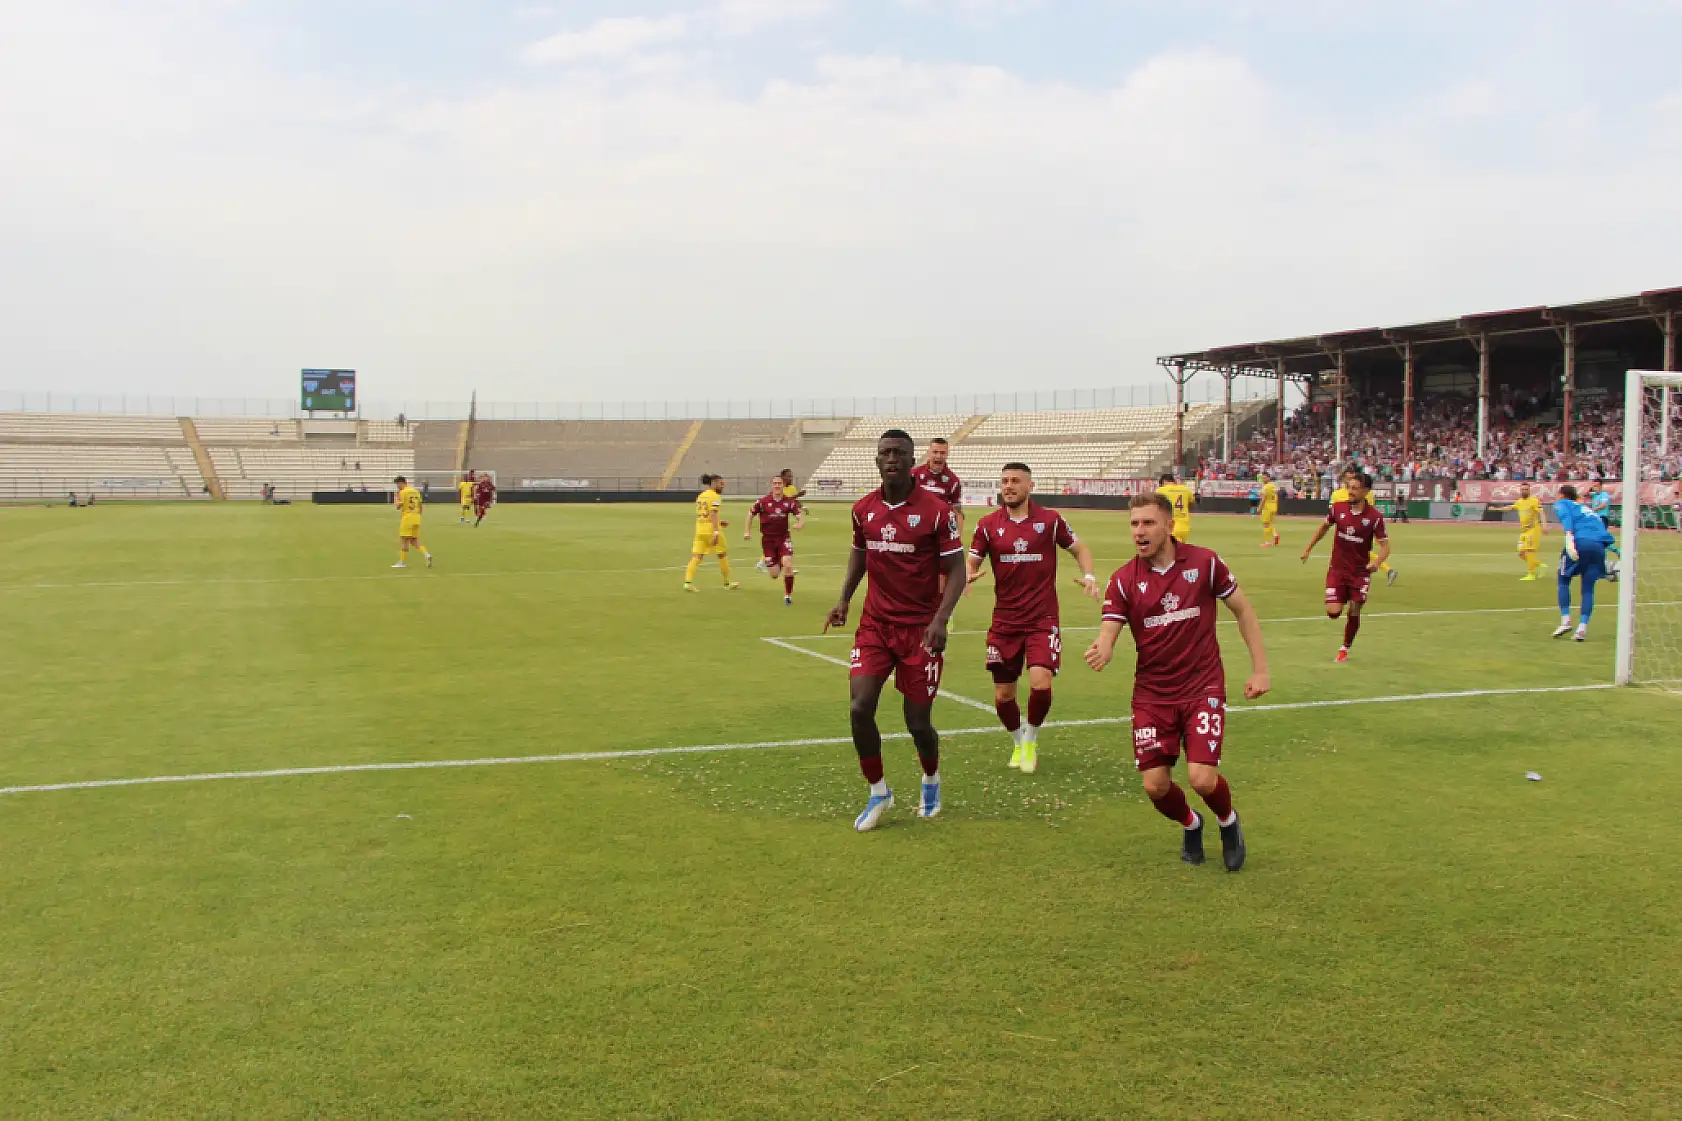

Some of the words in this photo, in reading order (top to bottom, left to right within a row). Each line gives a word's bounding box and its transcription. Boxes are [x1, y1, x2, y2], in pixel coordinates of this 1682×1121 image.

[1175, 495, 1184, 512] 4
[1048, 633, 1062, 653] 10
[924, 661, 939, 682] 11
[1196, 711, 1221, 736] 33
